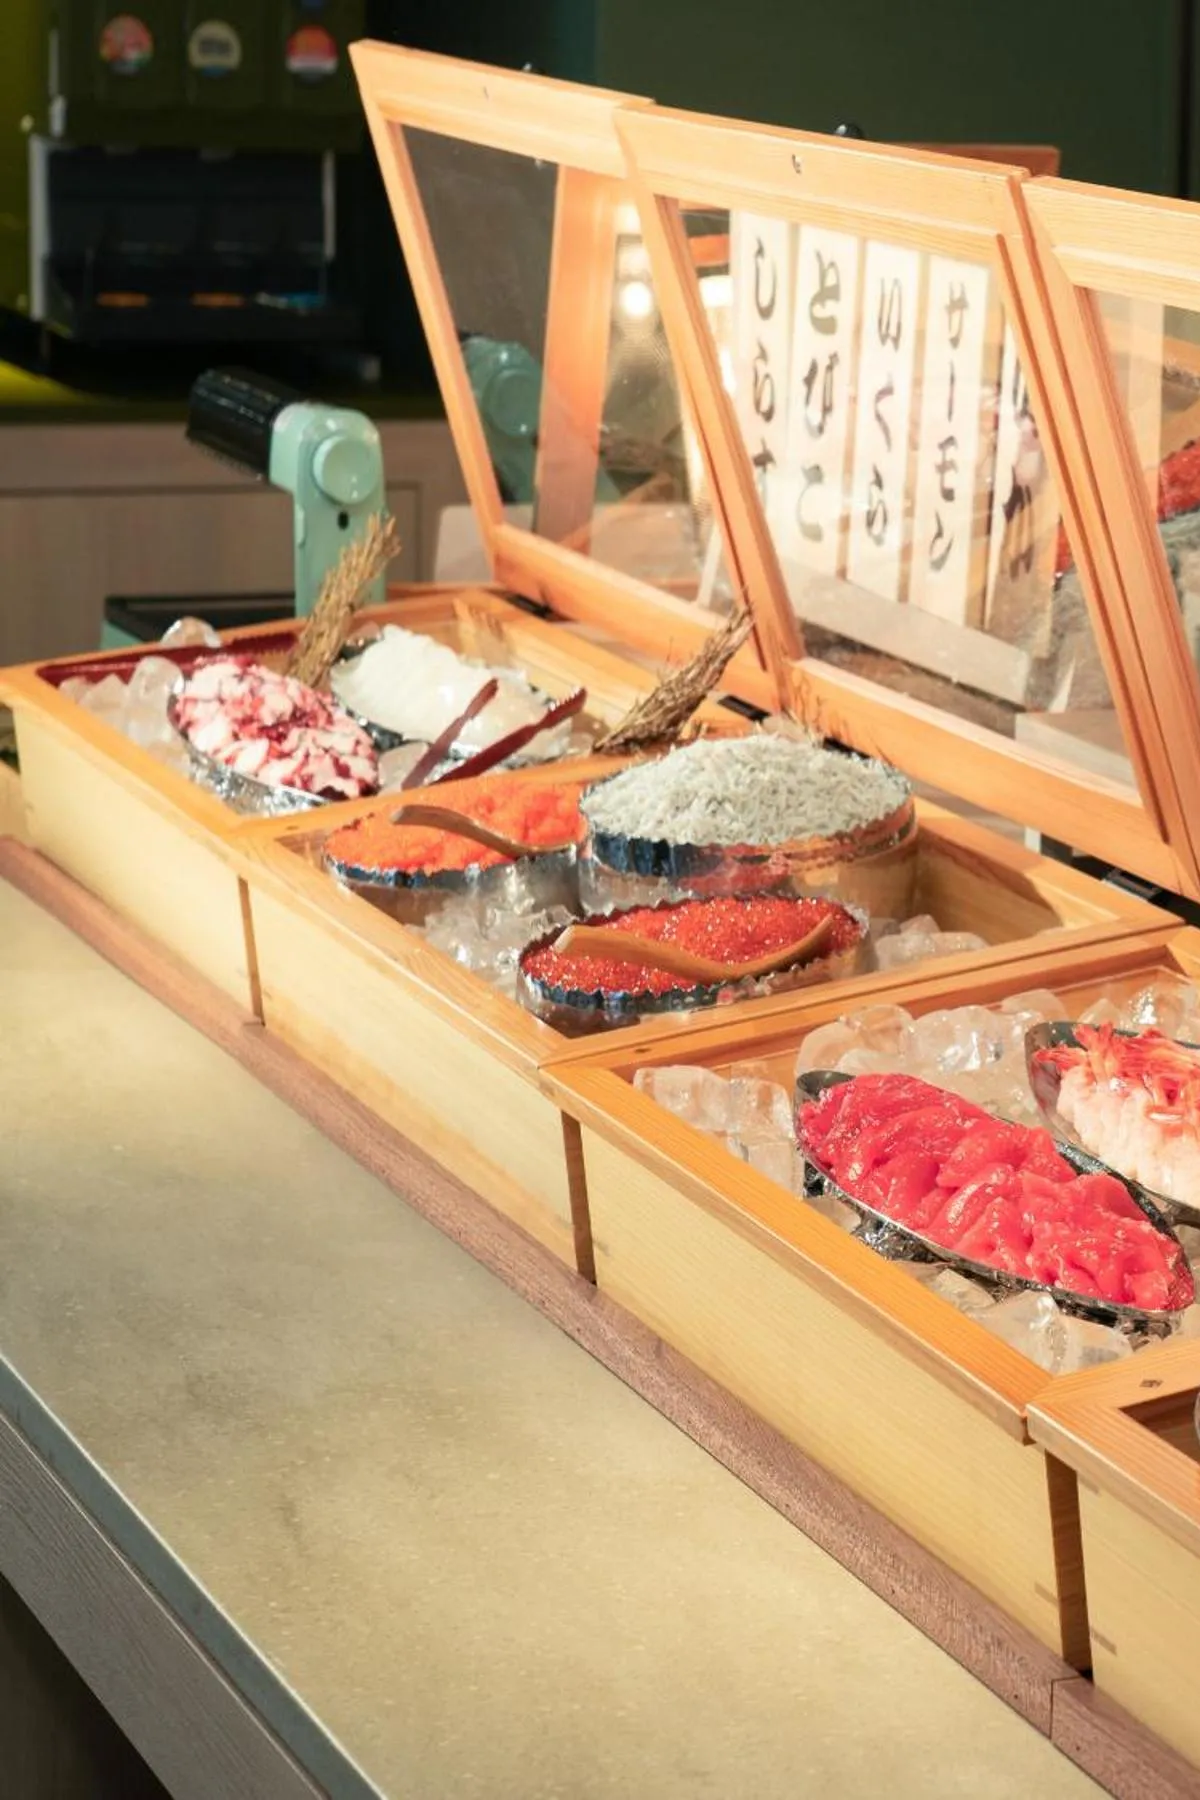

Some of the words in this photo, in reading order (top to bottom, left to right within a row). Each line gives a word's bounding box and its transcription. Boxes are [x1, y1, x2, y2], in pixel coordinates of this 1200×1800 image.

[796, 248, 841, 543] とびこ
[866, 277, 902, 546] いくら
[928, 281, 969, 572] サーモン
